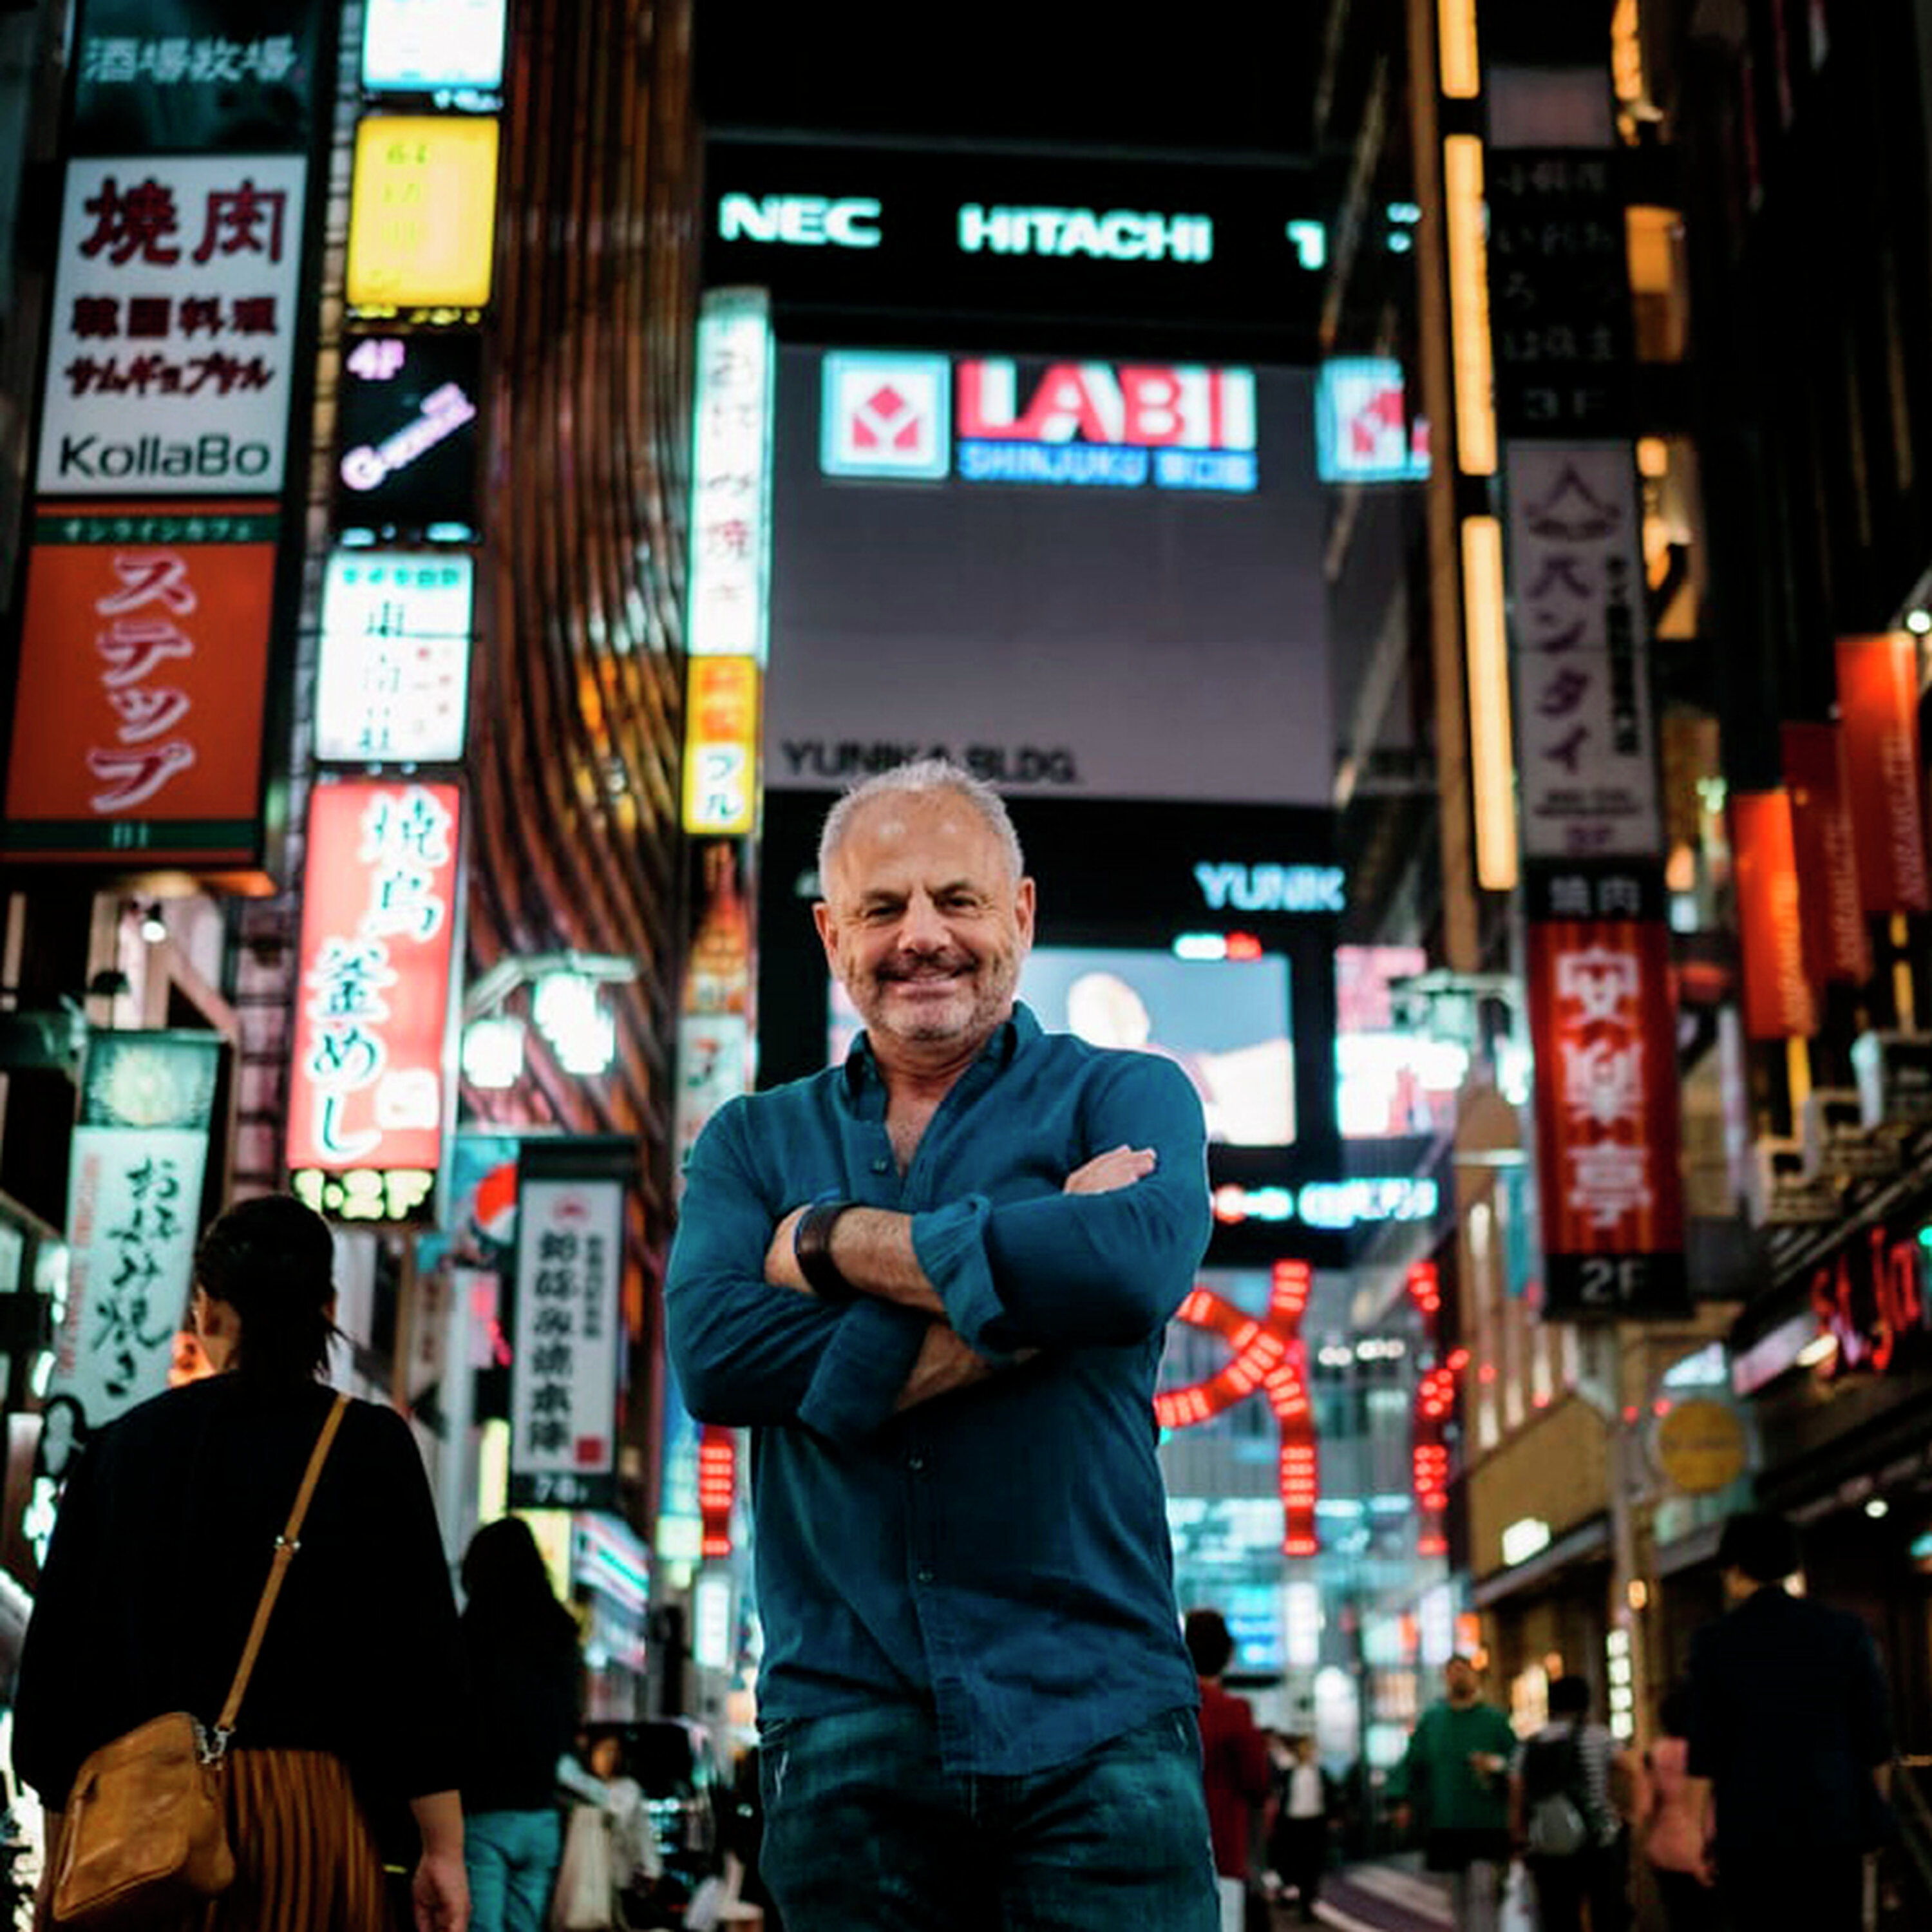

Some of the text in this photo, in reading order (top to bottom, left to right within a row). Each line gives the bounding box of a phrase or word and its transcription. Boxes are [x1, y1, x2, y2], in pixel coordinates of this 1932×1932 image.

[718, 191, 882, 248] NEC
[956, 201, 1213, 264] HITACHI
[958, 357, 1257, 452] LABI
[59, 433, 270, 478] KollaBo
[86, 553, 197, 813] ステップ
[304, 934, 399, 1164] 釜めし
